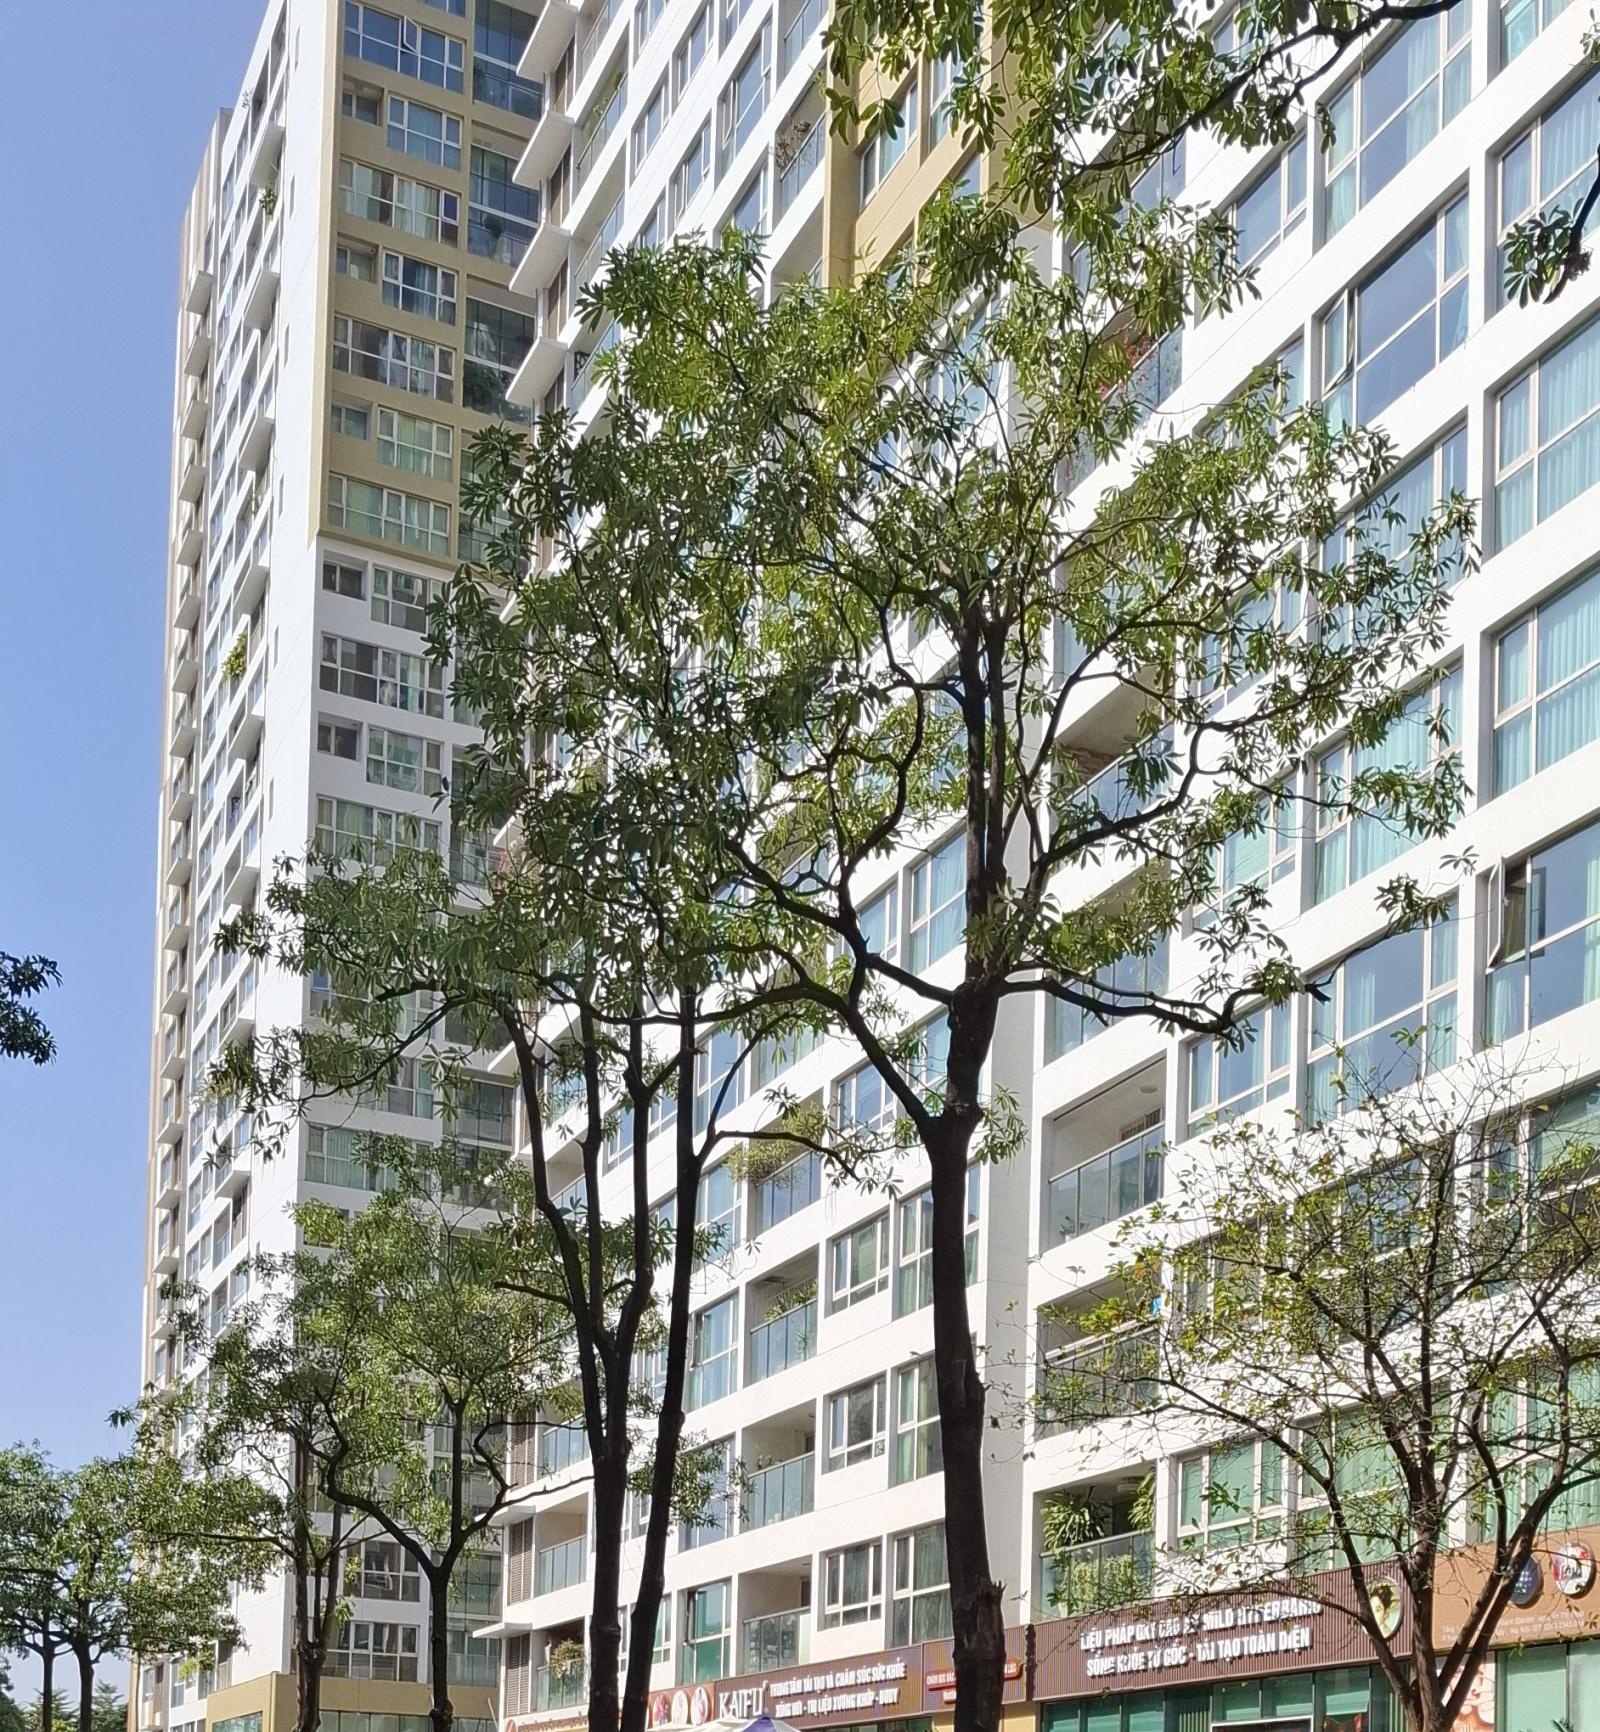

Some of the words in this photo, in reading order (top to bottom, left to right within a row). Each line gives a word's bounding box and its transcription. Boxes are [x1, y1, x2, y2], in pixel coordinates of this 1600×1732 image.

[1087, 1649, 1116, 1676] SỐNG
[1163, 1639, 1187, 1665] GỐC
[1196, 1638, 1215, 1662] TÁI
[1217, 1638, 1241, 1662] TẠO
[1242, 1630, 1276, 1655] TOÀN
[1279, 1625, 1312, 1652] DIỆN
[1105, 1622, 1135, 1647] PHÁP
